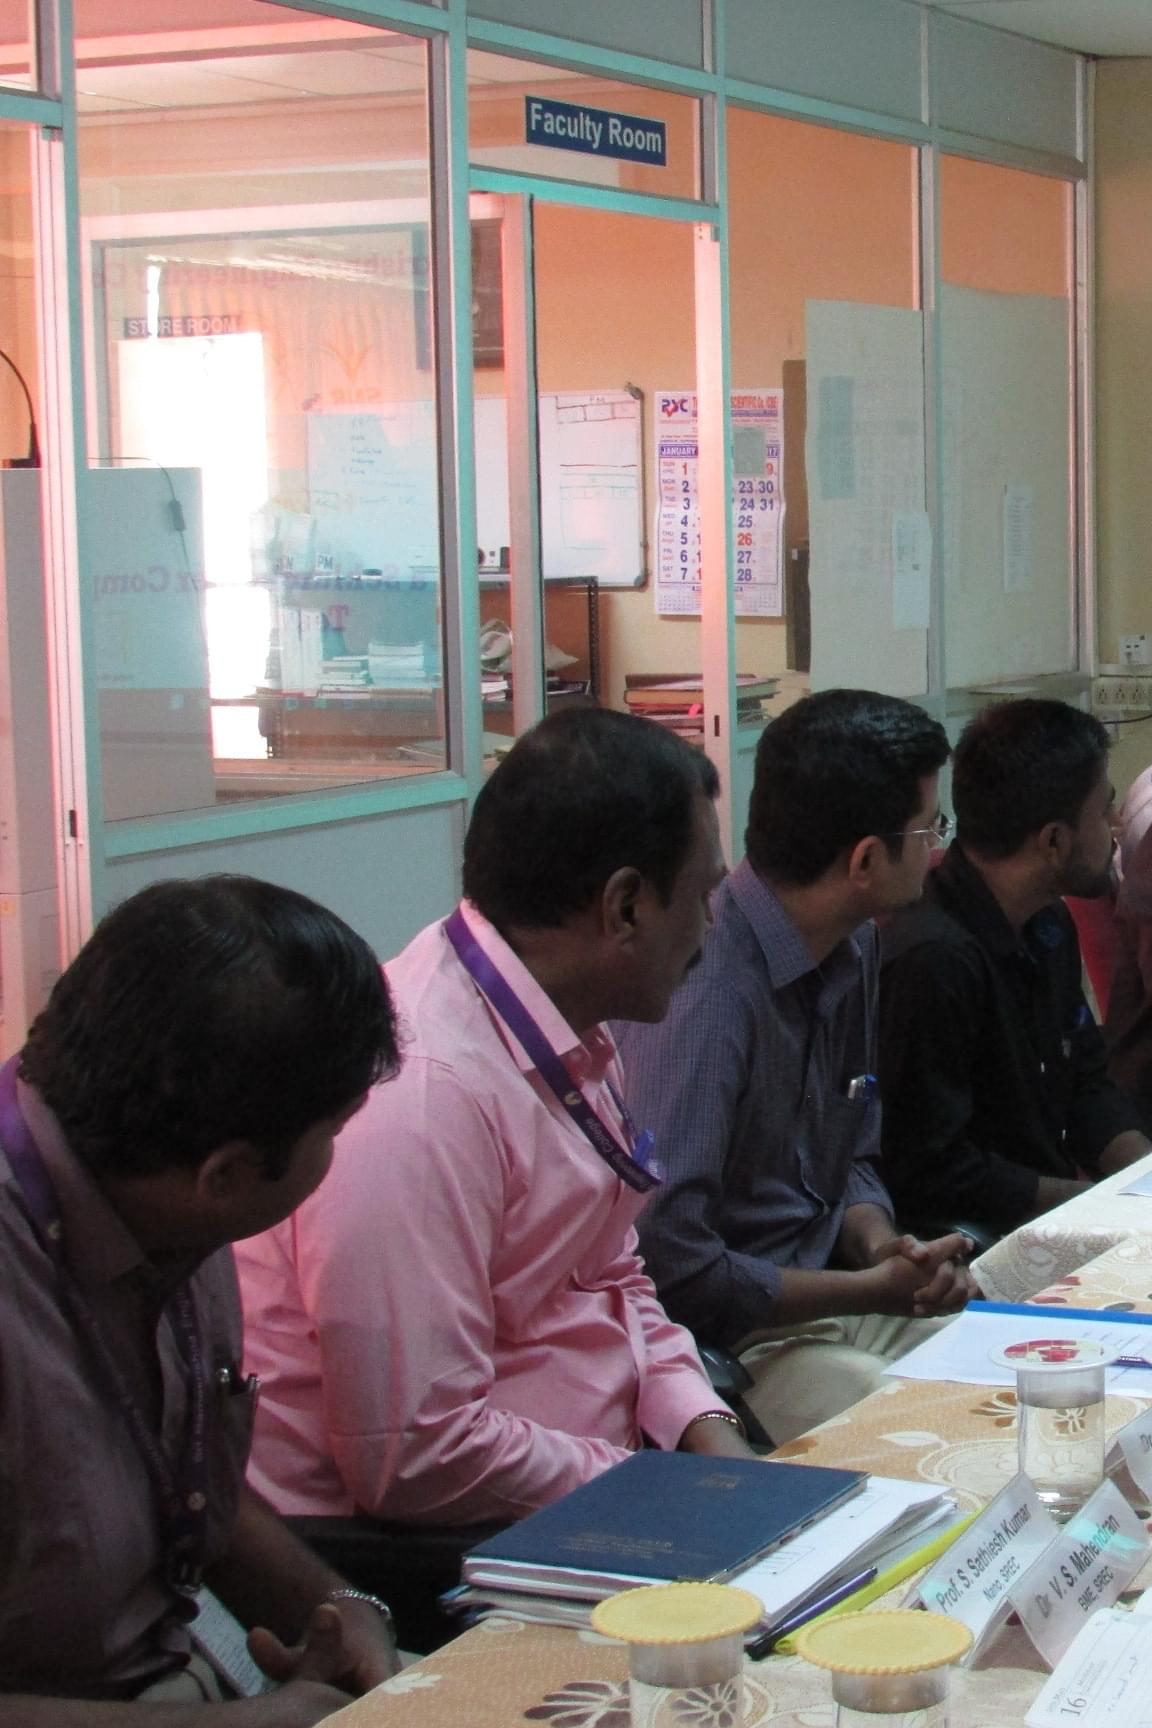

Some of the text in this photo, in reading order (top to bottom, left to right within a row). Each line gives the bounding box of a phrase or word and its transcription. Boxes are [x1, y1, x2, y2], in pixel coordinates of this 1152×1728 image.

[530, 102, 662, 153] Faculty Room
[128, 317, 238, 336] STRE ROOM
[660, 446, 696, 457] JANUARY
[683, 463, 687, 475] 1
[682, 481, 689, 492] 2
[739, 482, 753, 493] 23
[759, 482, 773, 493] 30
[683, 498, 690, 510] 3
[740, 499, 754, 510] 24
[760, 499, 773, 510] 31
[681, 516, 688, 527] 4
[738, 516, 752, 527] 25
[680, 533, 687, 545] 5
[737, 534, 752, 545] 26
[680, 551, 687, 562] 6
[737, 552, 752, 563] 27
[681, 568, 687, 580] 7
[737, 569, 752, 581] 28
[936, 1503, 1032, 1614] Prof. S. Sathiesh Kumar
[1049, 1575, 1067, 1600] V.
[1059, 1565, 1078, 1588] S.
[1070, 1514, 1121, 1576] Mahendran
[1000, 1556, 1021, 1586] SREC
[1093, 1565, 1115, 1594] SREC
[1060, 1698, 1087, 1716] 16
